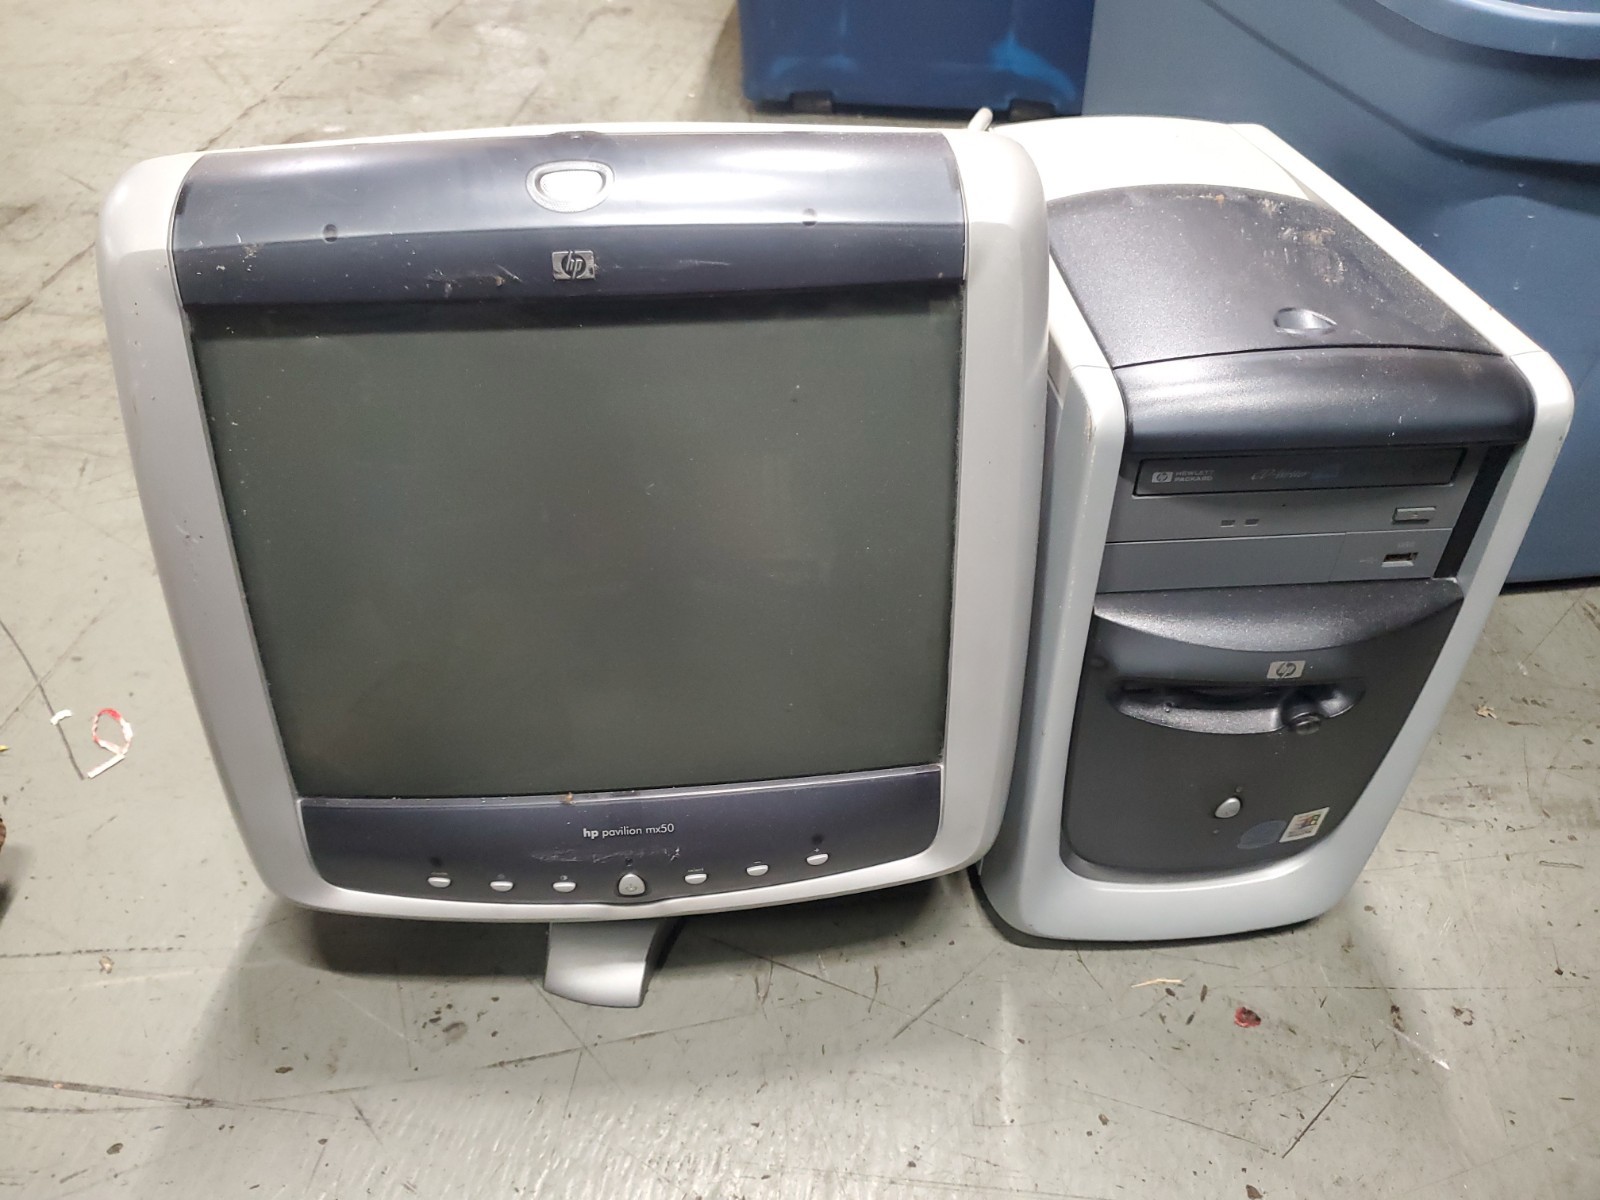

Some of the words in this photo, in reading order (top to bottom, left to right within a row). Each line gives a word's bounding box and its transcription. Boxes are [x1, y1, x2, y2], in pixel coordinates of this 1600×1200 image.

[562, 250, 586, 279] hp
[583, 828, 599, 839] hp
[602, 826, 642, 838] pavilion
[645, 823, 675, 834] mx50
